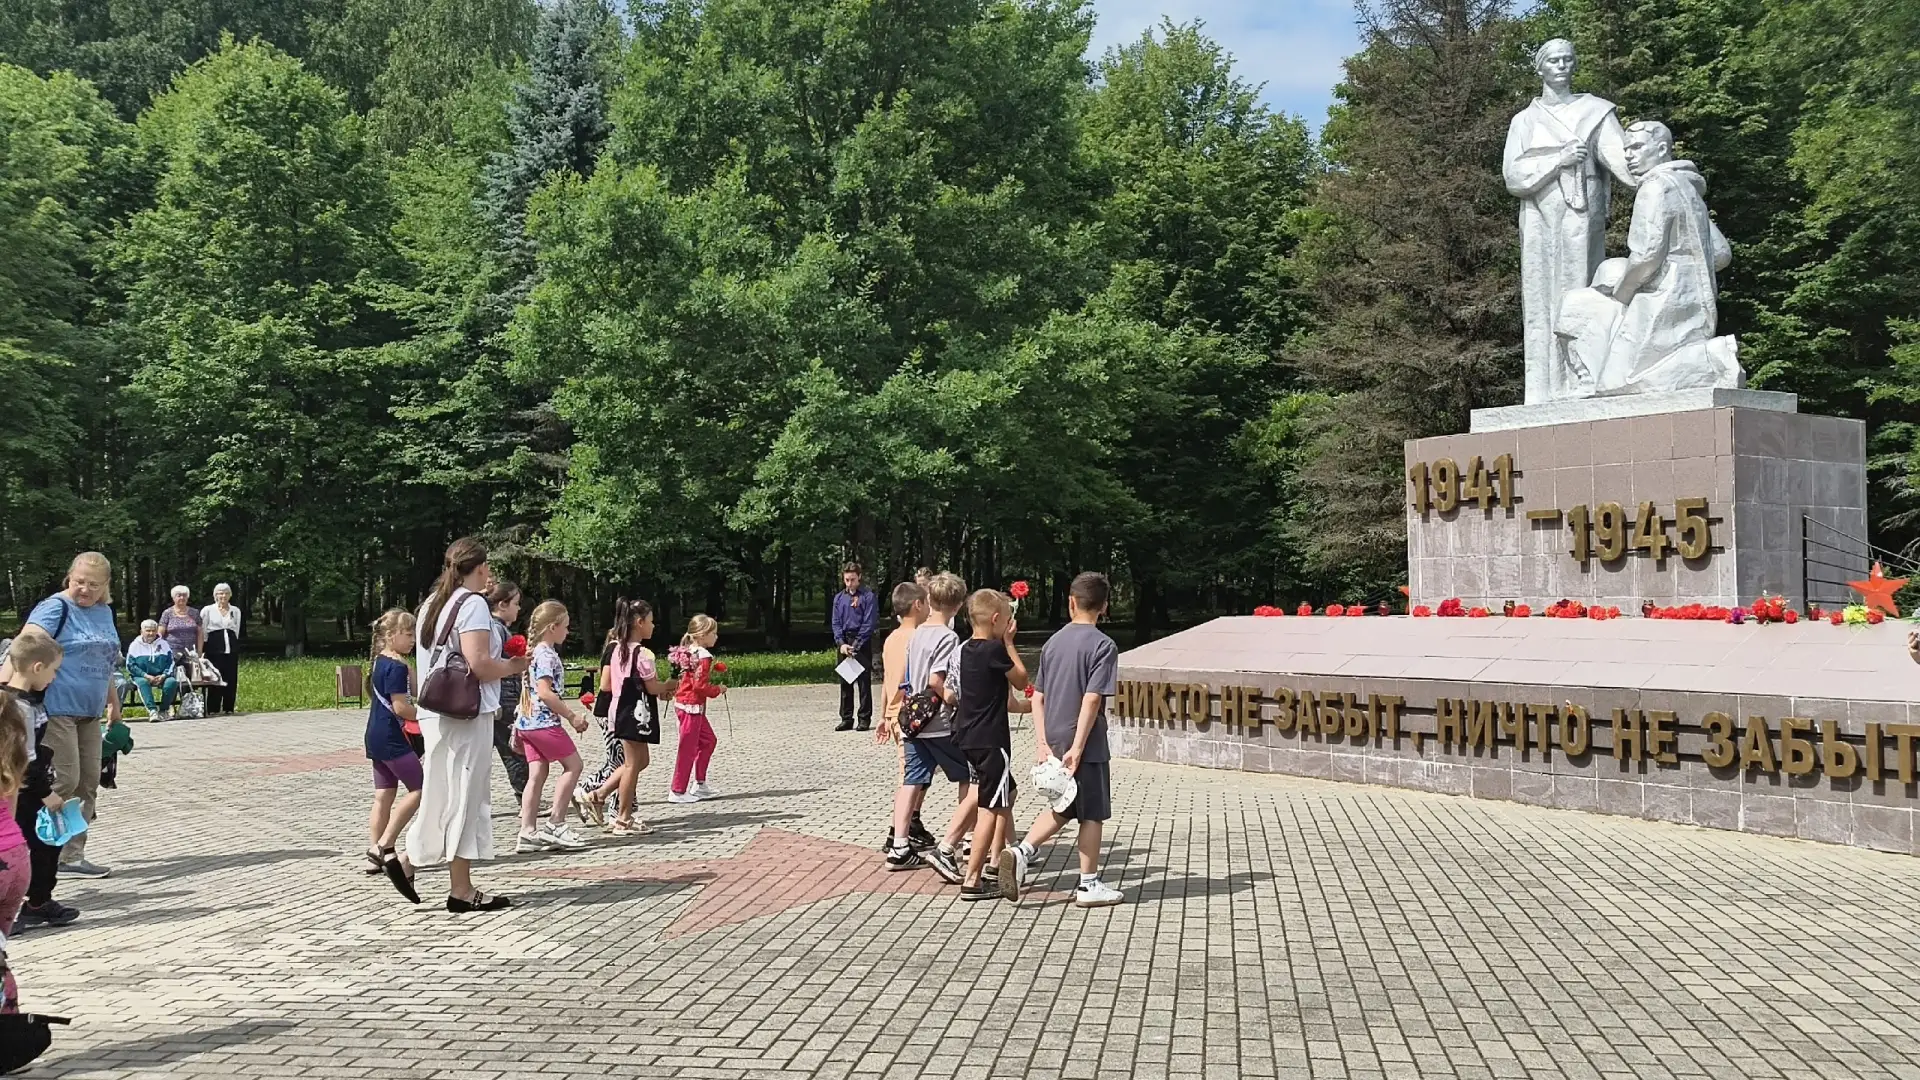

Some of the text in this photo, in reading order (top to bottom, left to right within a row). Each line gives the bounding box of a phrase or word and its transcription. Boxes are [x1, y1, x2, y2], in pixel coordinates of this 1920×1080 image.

[1410, 453, 1515, 514] 1941
[1113, 680, 1210, 724] НИКТО
[1220, 684, 1262, 729] НЕ
[1436, 697, 1590, 757] НИЧТО
[1611, 707, 1679, 764] НЕ
[1700, 711, 1920, 785] ЗАБЫТ
